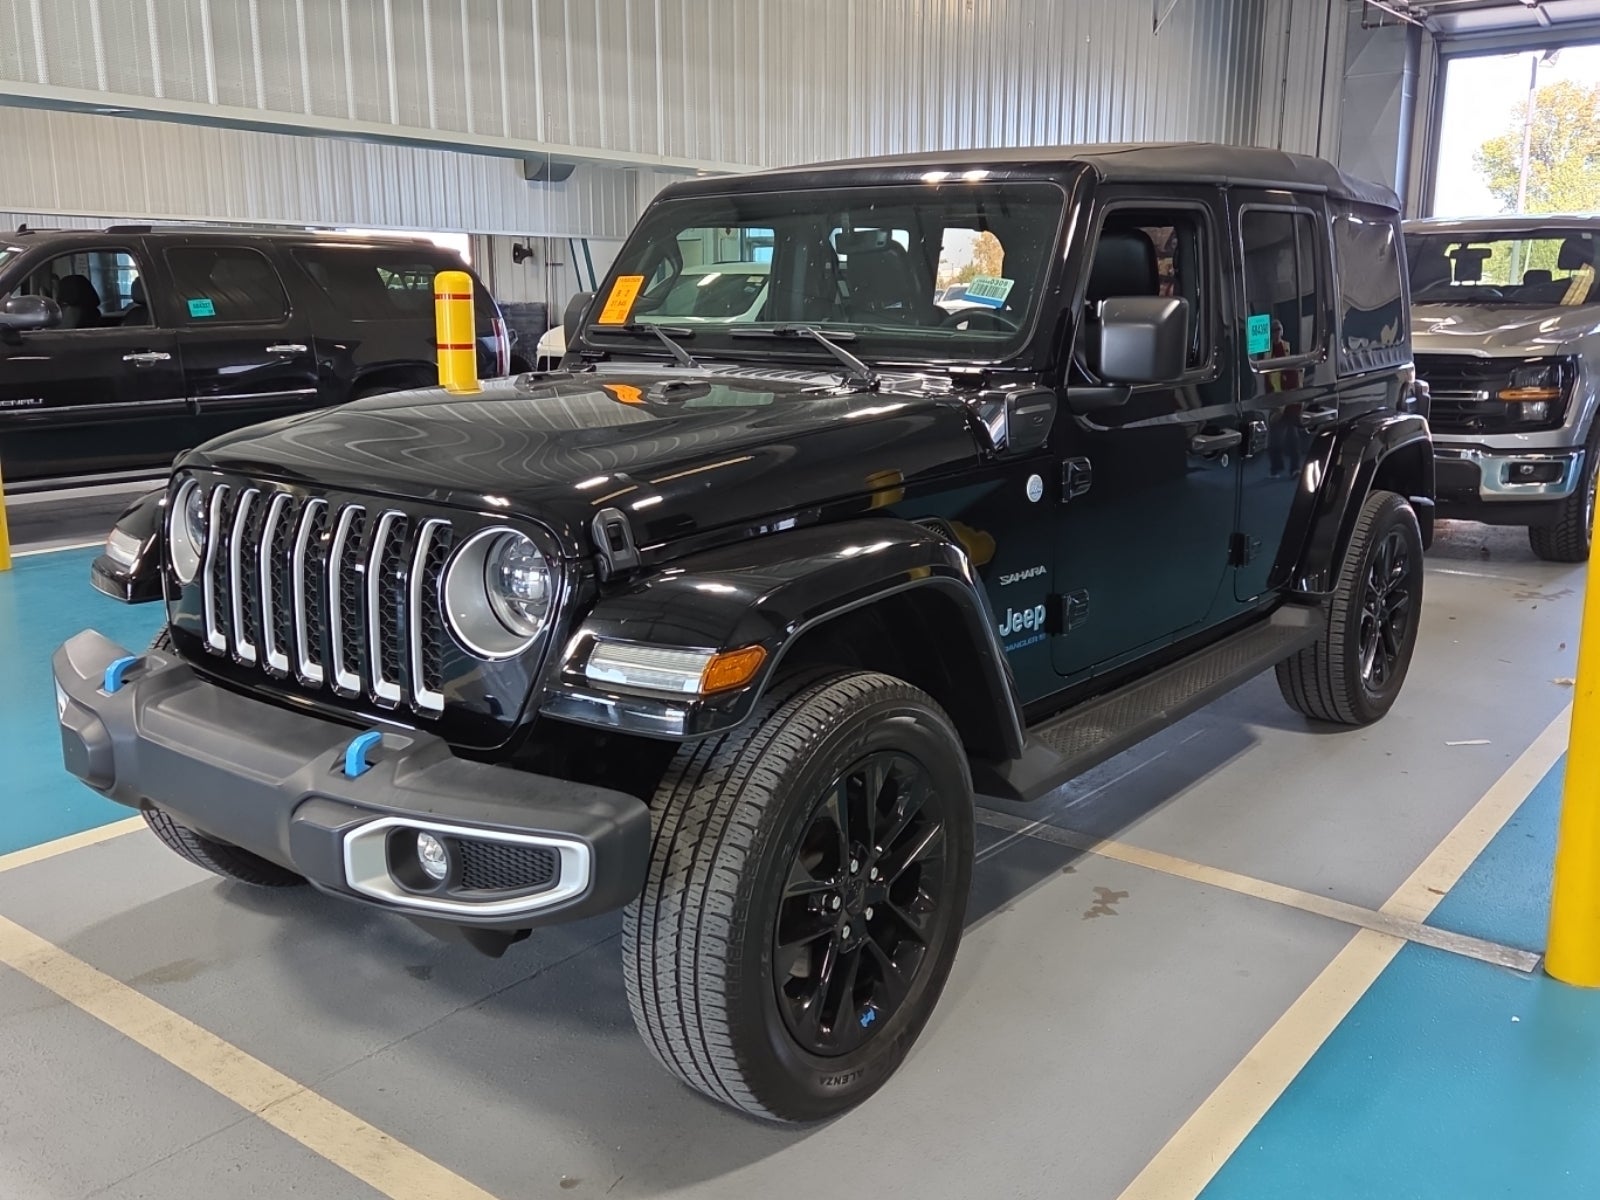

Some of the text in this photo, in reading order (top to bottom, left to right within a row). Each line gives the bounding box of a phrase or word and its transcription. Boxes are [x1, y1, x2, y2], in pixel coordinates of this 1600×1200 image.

[0, 398, 43, 407] ENALI
[999, 565, 1047, 586] SAHARA
[999, 604, 1046, 636] Jeep
[820, 1066, 864, 1086] ALENZA
